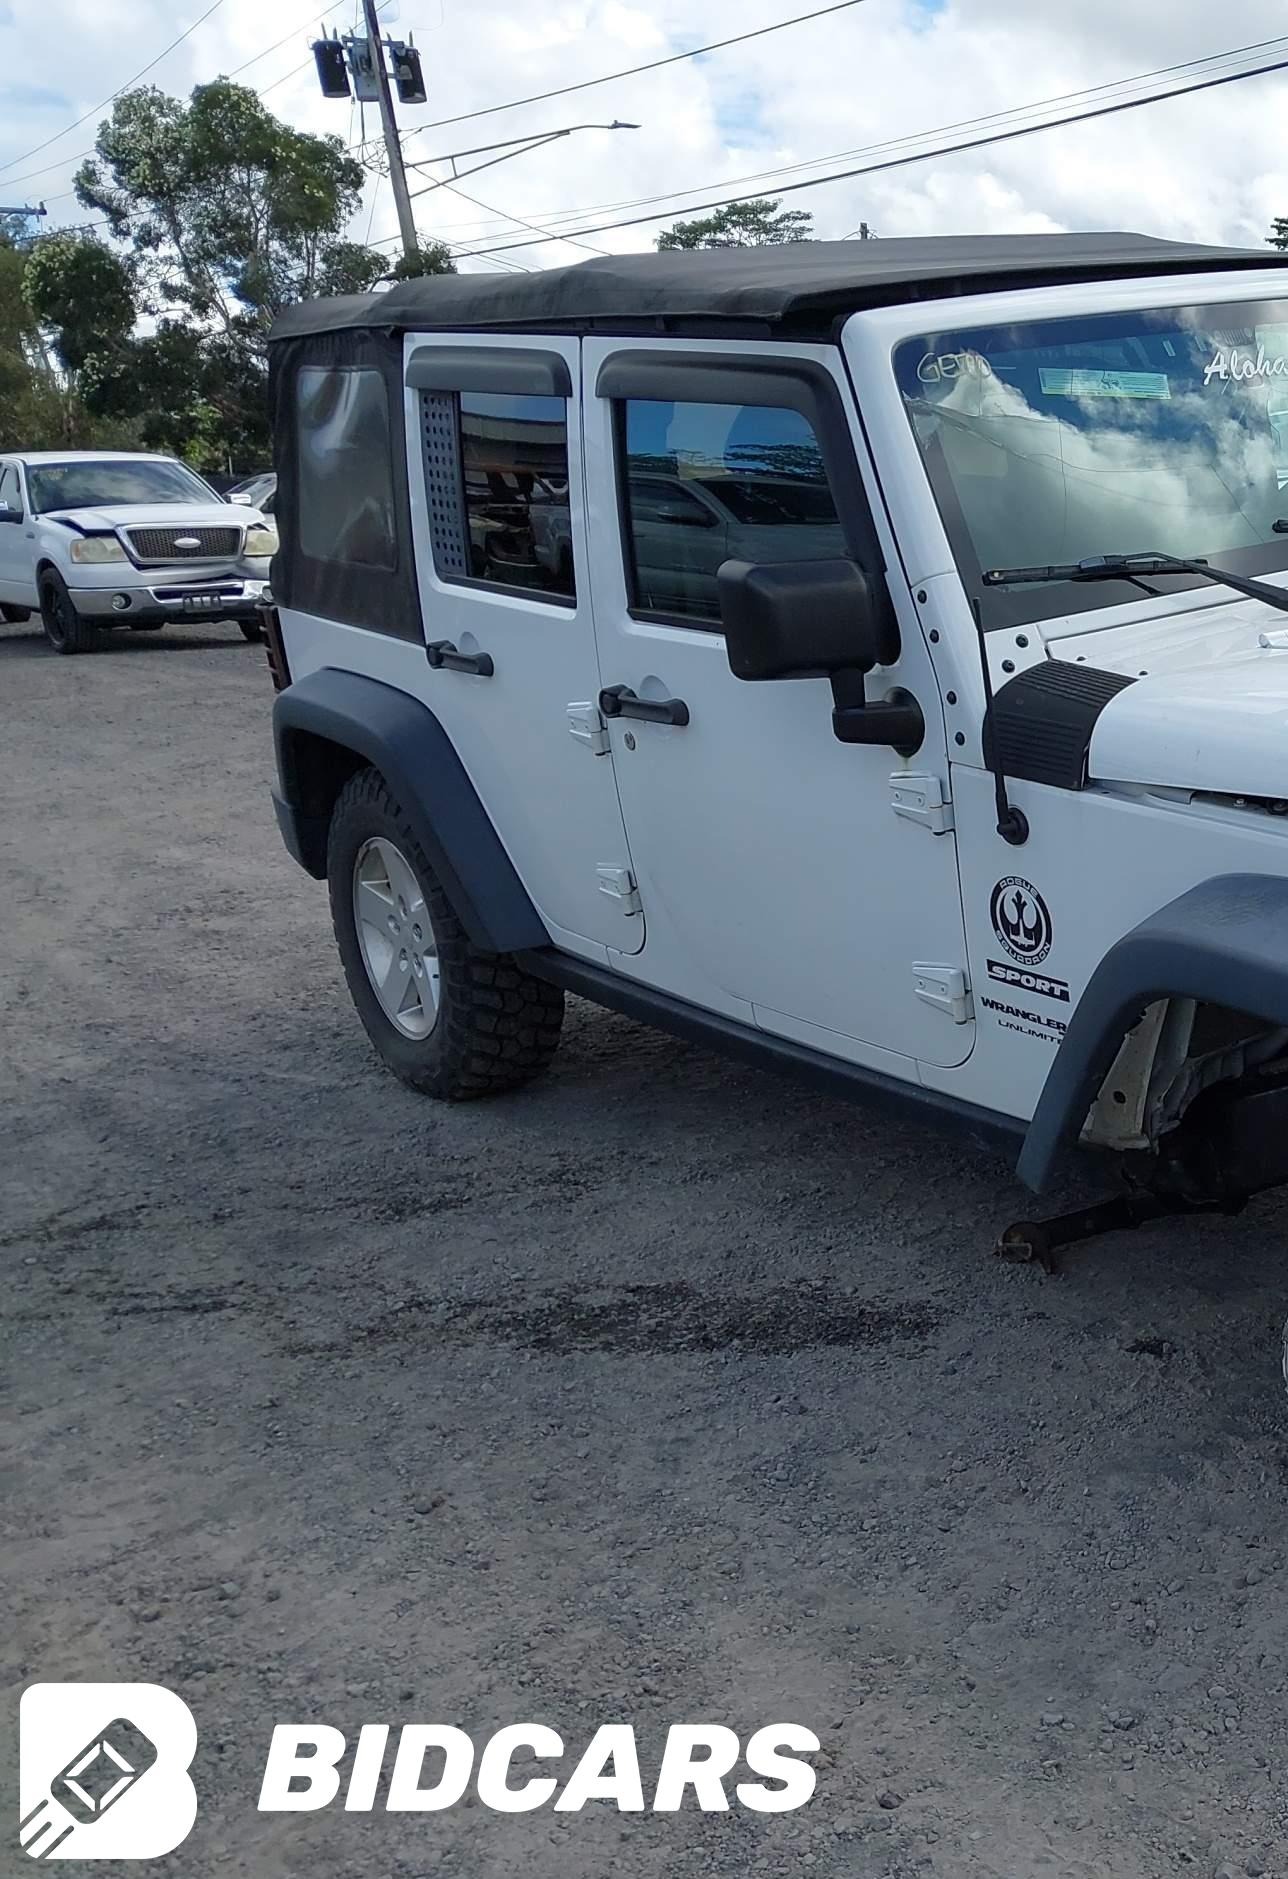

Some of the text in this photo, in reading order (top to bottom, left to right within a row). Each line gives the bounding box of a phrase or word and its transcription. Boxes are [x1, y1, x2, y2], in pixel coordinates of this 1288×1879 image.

[1000, 877, 1038, 898] ROGUE
[996, 930, 1050, 966] SQUADRON
[991, 964, 1069, 996] SPORT
[981, 996, 1067, 1033] WRANGLER
